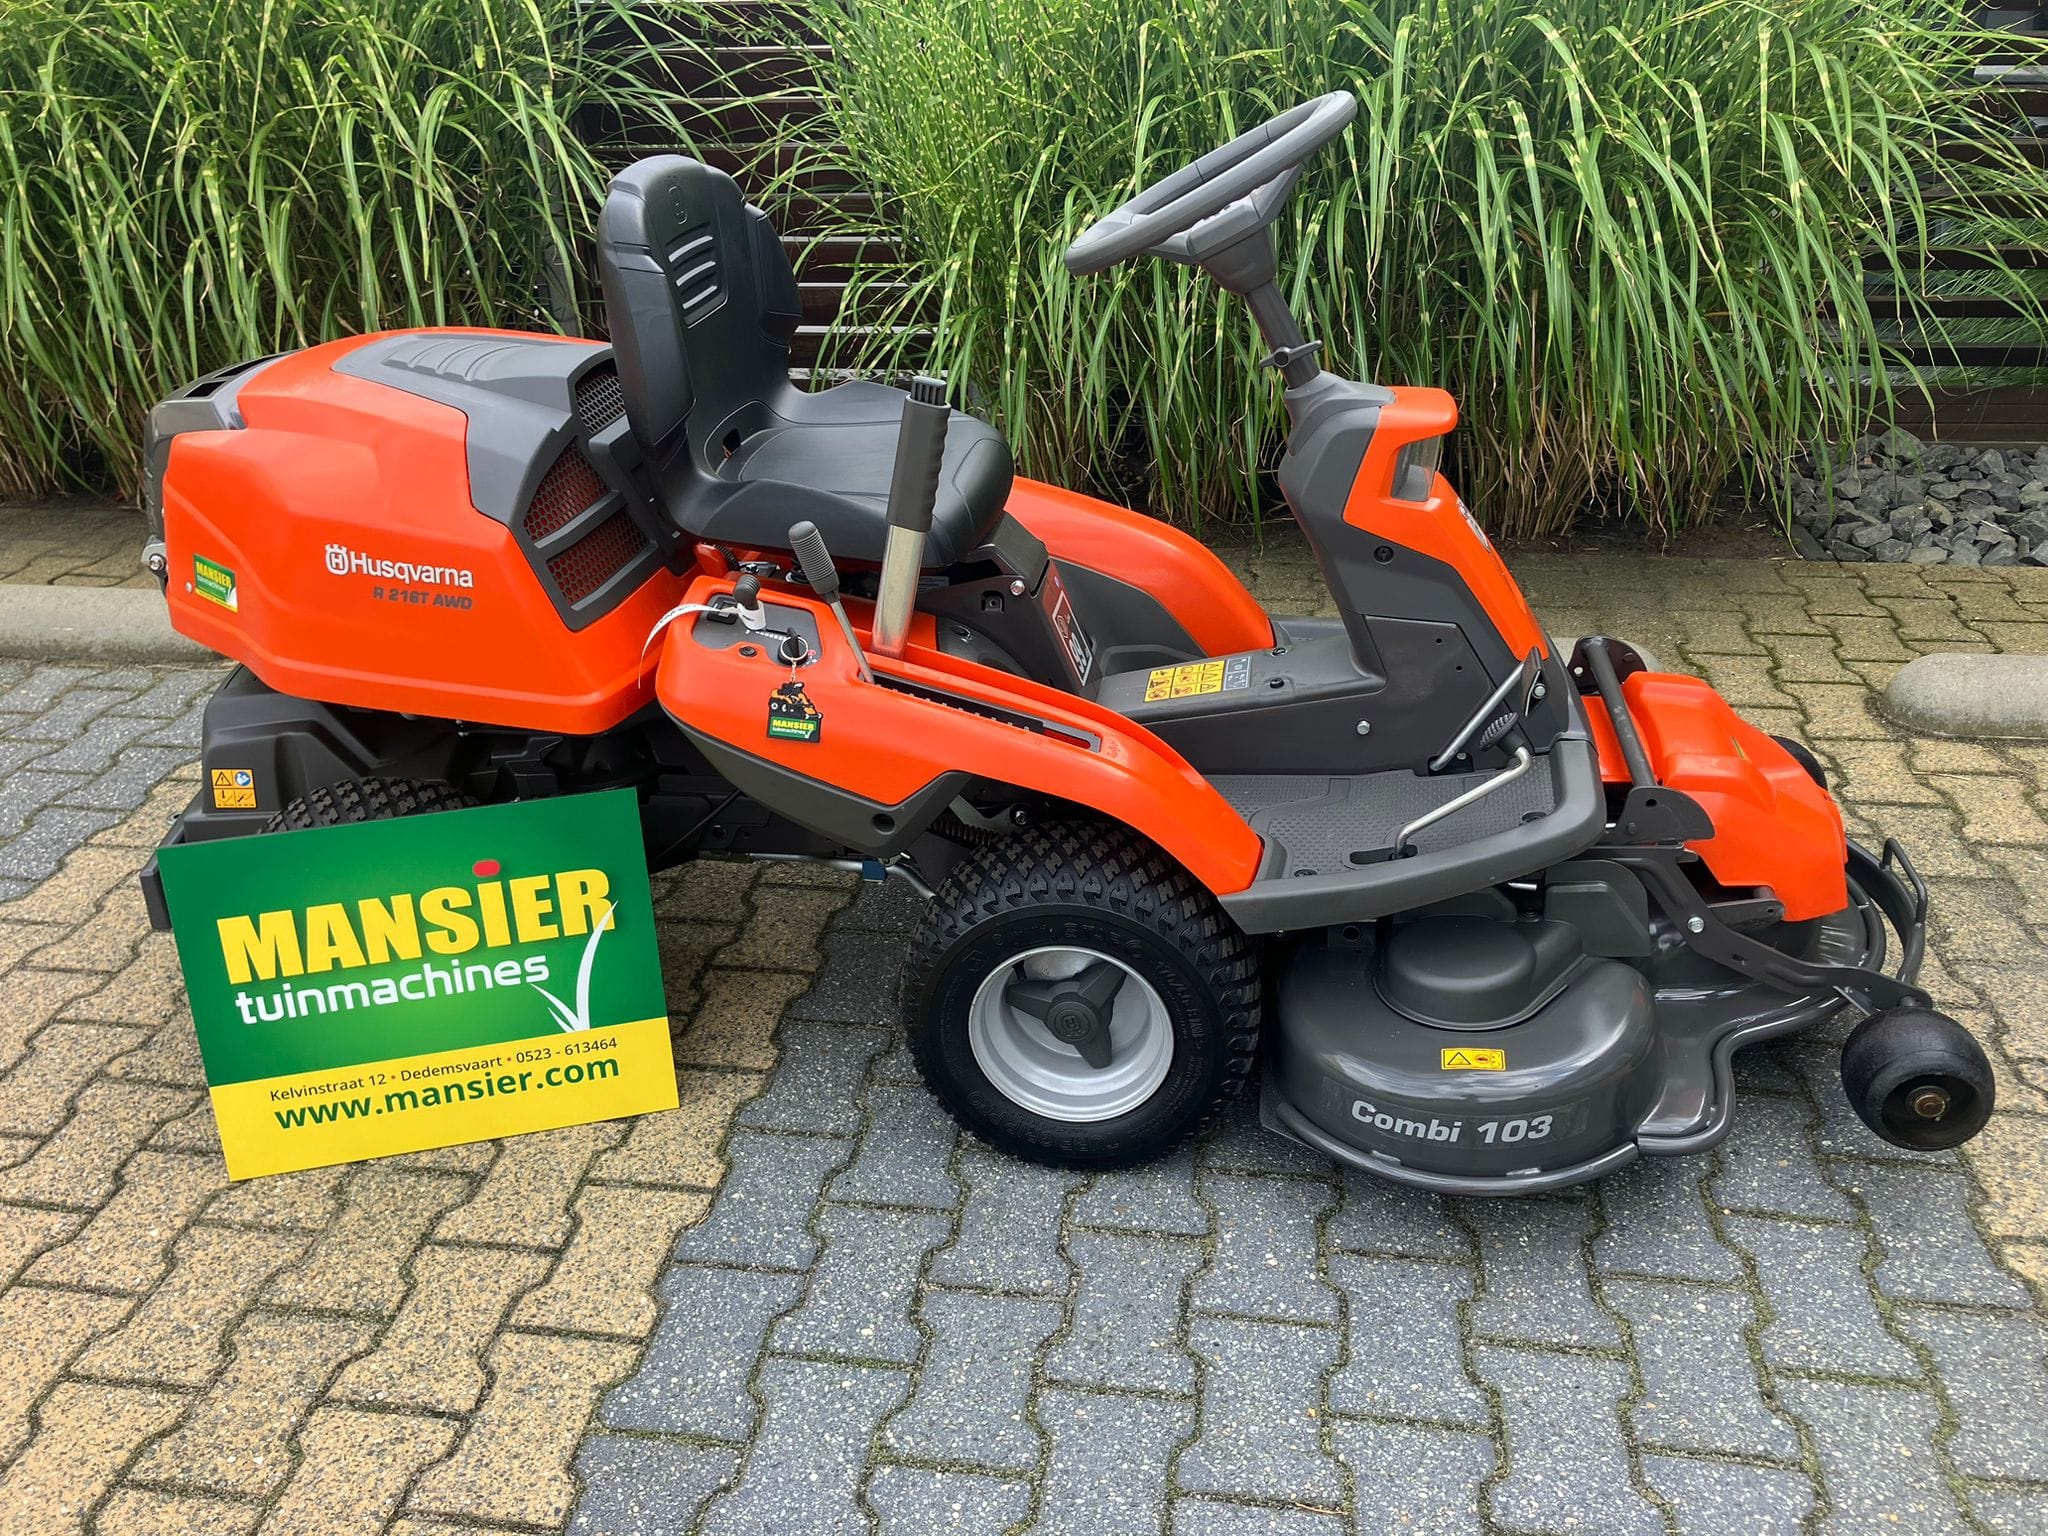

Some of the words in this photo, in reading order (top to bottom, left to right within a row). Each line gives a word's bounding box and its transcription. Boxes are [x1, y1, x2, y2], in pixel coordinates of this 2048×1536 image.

[350, 550, 474, 588] Husqvarna
[372, 586, 384, 599] R
[433, 594, 473, 610] AWD
[235, 954, 550, 1025] tuinmachines
[270, 1077, 365, 1101] Kelvinstraat
[369, 1073, 387, 1086] 12
[401, 1056, 503, 1081] Dedemsvaart
[516, 1047, 552, 1063] 0523
[565, 1037, 618, 1055] 613464
[274, 1057, 620, 1129] www.mansier.com
[1351, 1099, 1463, 1143] Combi
[1476, 1114, 1554, 1144] 103
